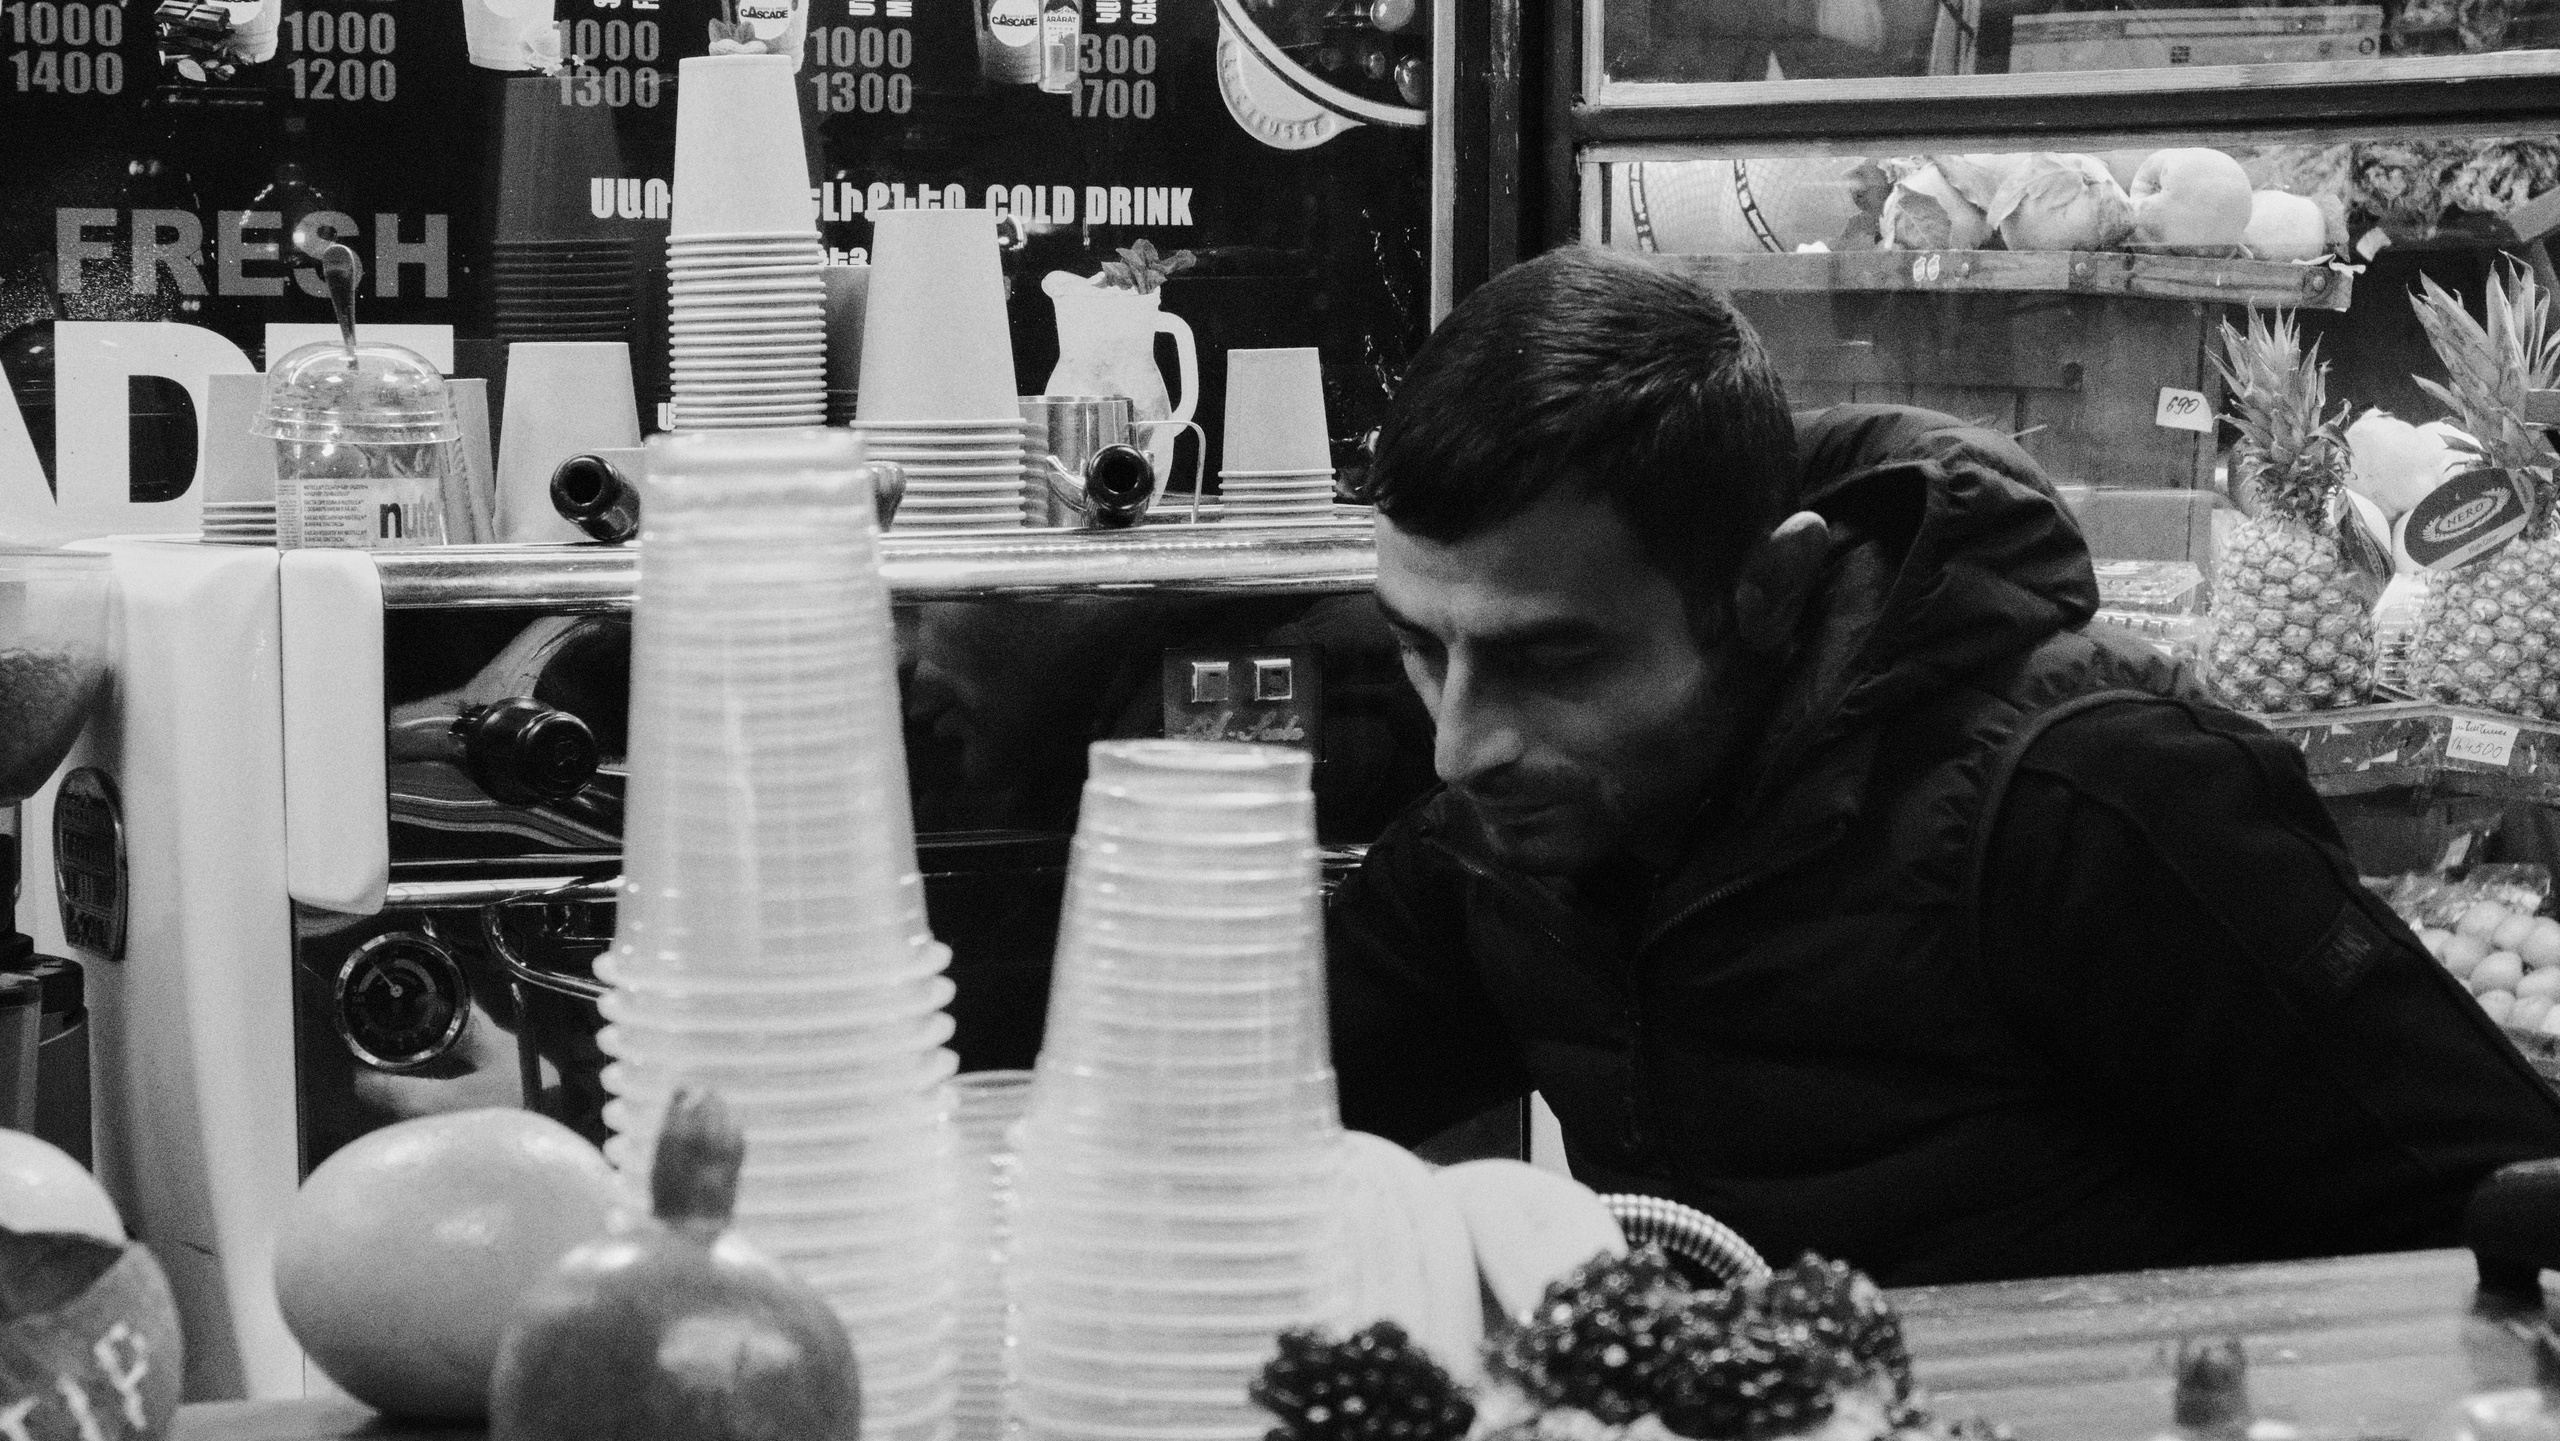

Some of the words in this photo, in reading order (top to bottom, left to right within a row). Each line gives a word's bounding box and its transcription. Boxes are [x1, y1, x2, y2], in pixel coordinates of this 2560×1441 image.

[5, 1, 123, 47] 1000
[283, 10, 397, 55] 1000
[740, 6, 788, 19] CASCADE
[992, 13, 1037, 27] CASCADE
[1131, 0, 1157, 24] CA
[552, 19, 660, 61] 1000
[809, 26, 912, 69] 1000
[8, 50, 123, 95] 1400
[286, 58, 397, 102] 1200
[553, 64, 660, 108] 1300
[809, 71, 912, 114] 1300
[1065, 79, 1157, 119] 1700
[986, 184, 1075, 225] COLD
[1086, 186, 1194, 226] DRINK
[56, 207, 449, 298] FRESH
